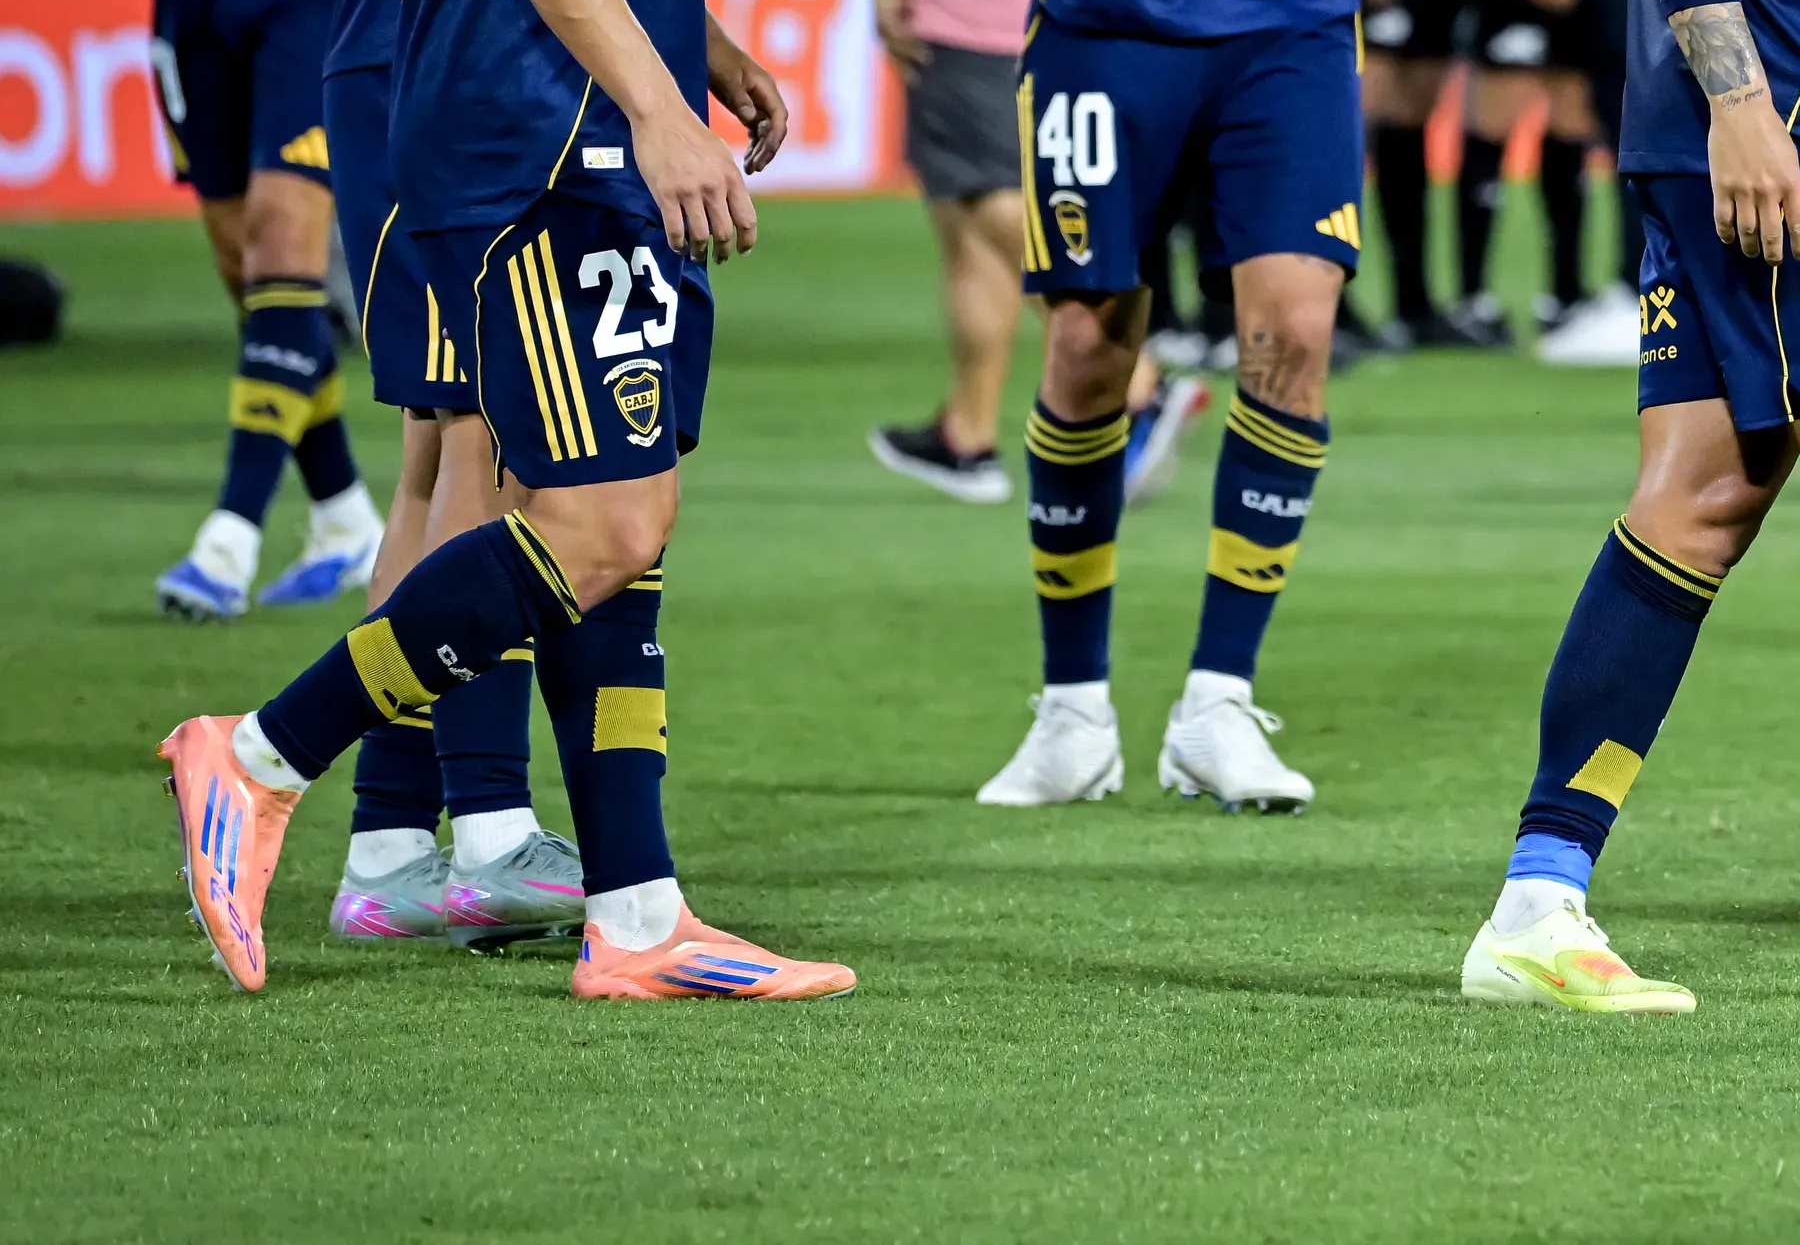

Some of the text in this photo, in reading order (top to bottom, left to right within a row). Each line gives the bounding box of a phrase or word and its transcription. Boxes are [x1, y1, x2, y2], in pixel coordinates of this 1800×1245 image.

[1037, 91, 1118, 186] 40
[578, 246, 679, 359] 23
[624, 392, 655, 410] CABJ
